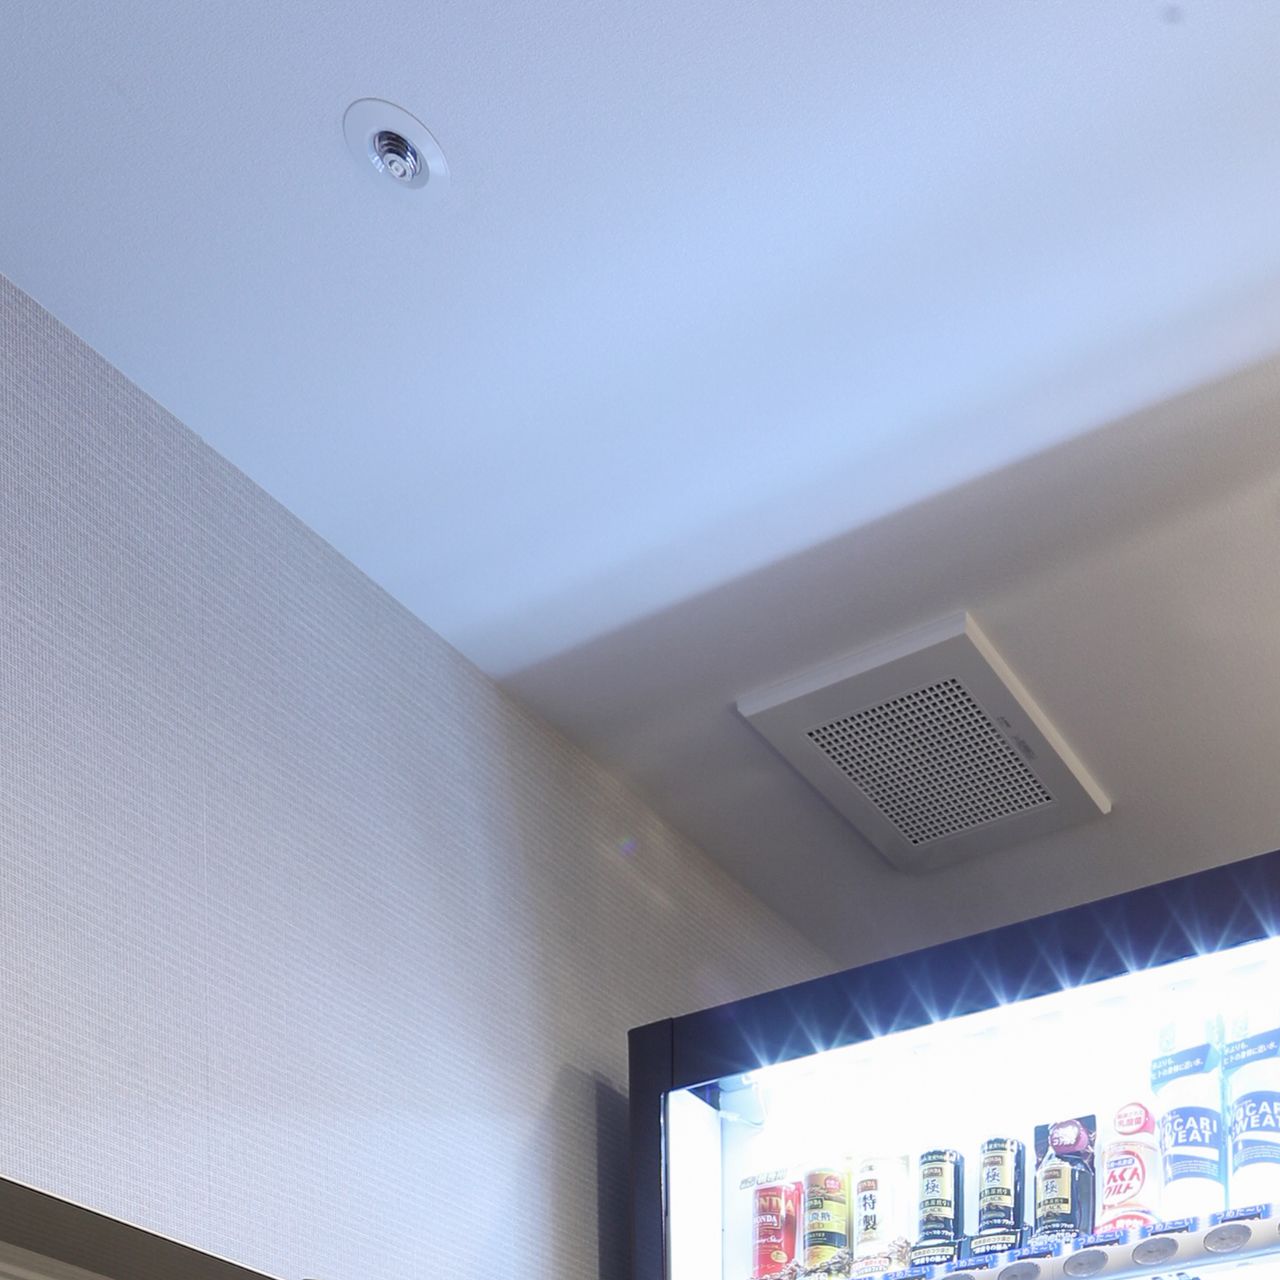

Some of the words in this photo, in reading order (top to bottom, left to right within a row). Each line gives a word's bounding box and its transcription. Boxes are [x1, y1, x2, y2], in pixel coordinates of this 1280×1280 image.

[985, 1167, 1000, 1183] 極
[925, 1179, 941, 1195] 極
[1044, 1181, 1058, 1196] 極
[862, 1194, 878, 1231] 特製
